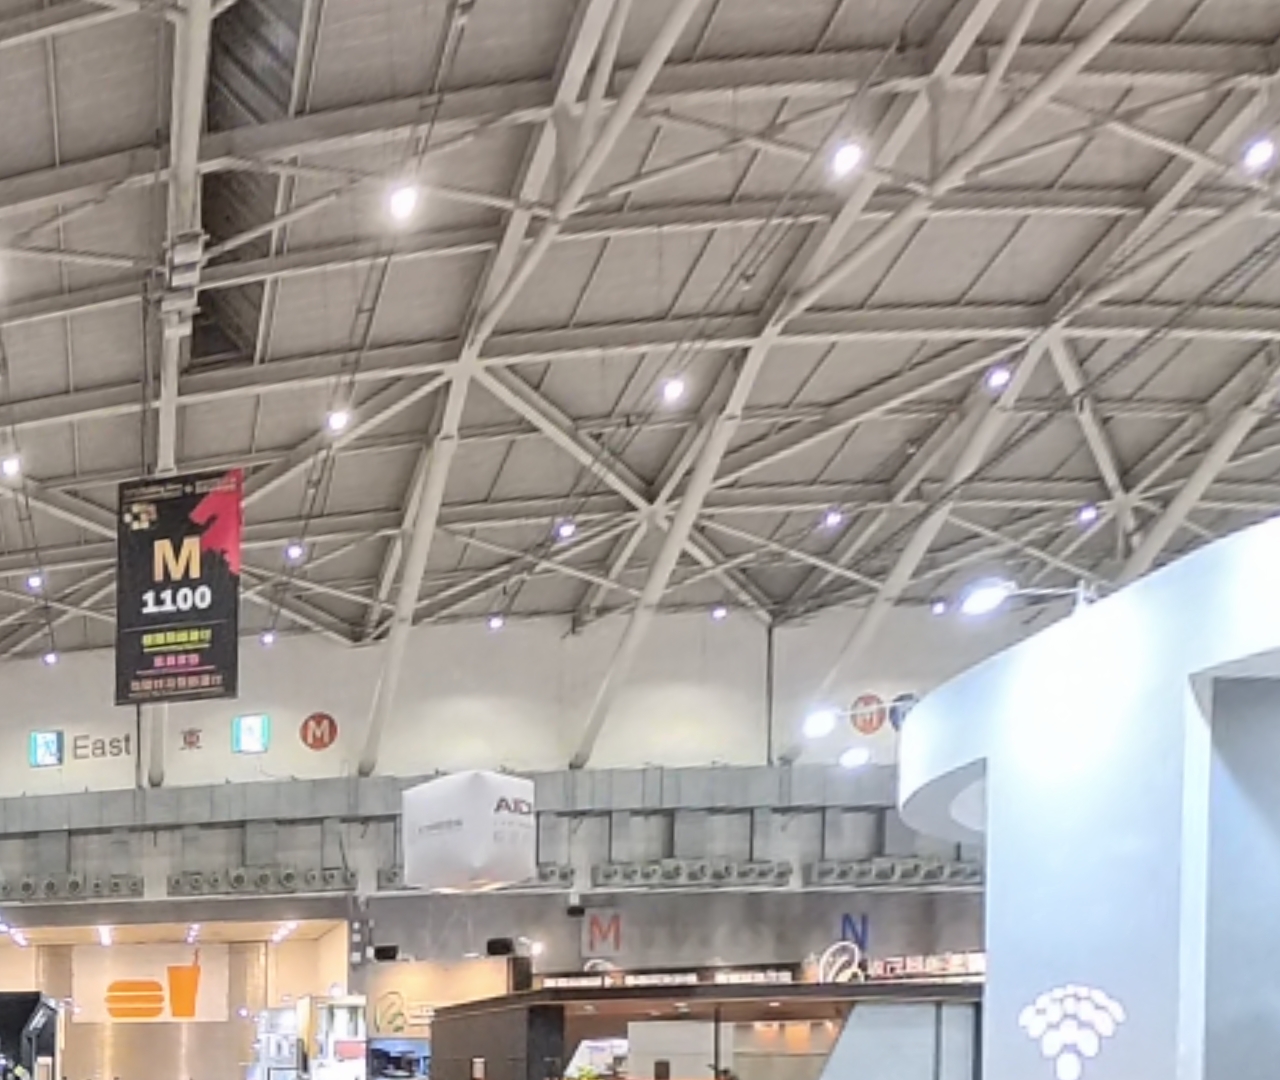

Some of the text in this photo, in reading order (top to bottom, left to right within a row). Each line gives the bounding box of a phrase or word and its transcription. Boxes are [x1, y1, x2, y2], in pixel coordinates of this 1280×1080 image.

[153, 534, 201, 582] M
[141, 584, 212, 614] 1100
[72, 732, 131, 760] East
[306, 718, 331, 745] M
[588, 913, 622, 952] M
[841, 912, 869, 951] N
